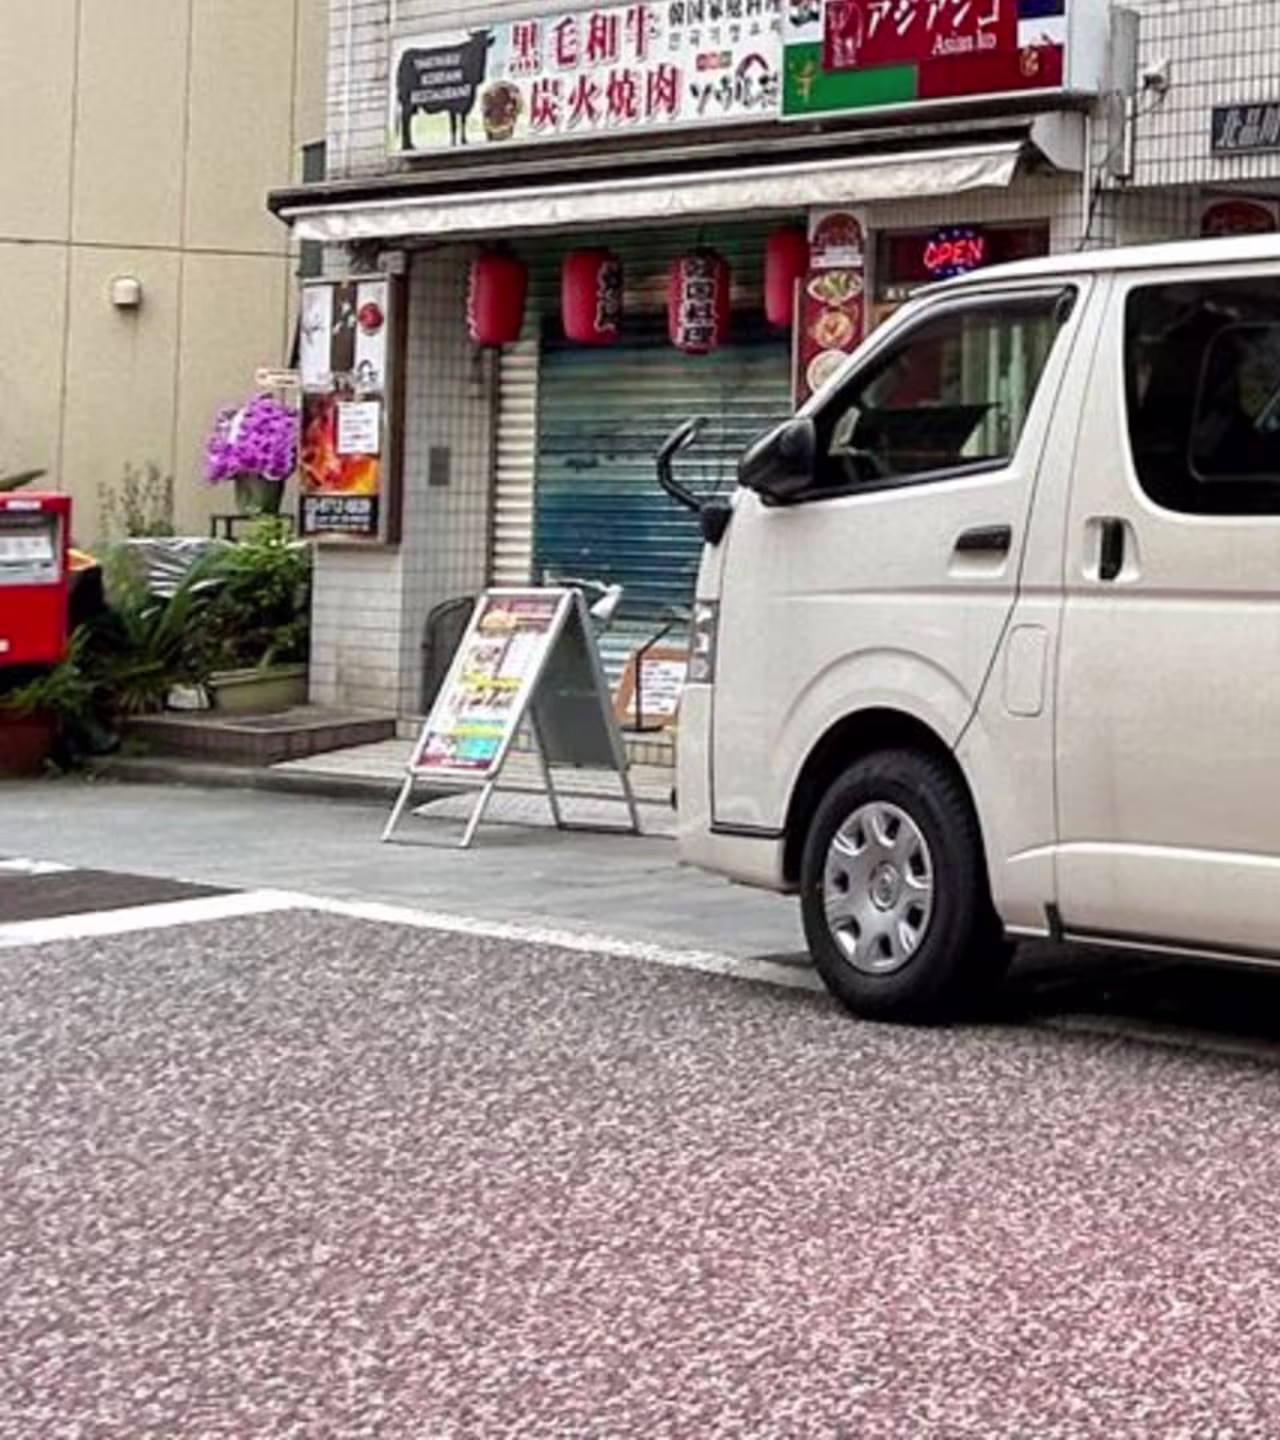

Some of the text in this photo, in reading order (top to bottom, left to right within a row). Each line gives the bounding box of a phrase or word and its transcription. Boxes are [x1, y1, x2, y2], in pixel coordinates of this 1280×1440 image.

[509, 3, 657, 74] 黒毛和牛
[530, 62, 680, 128] 炭火焼肉
[923, 238, 984, 269] OPEN
